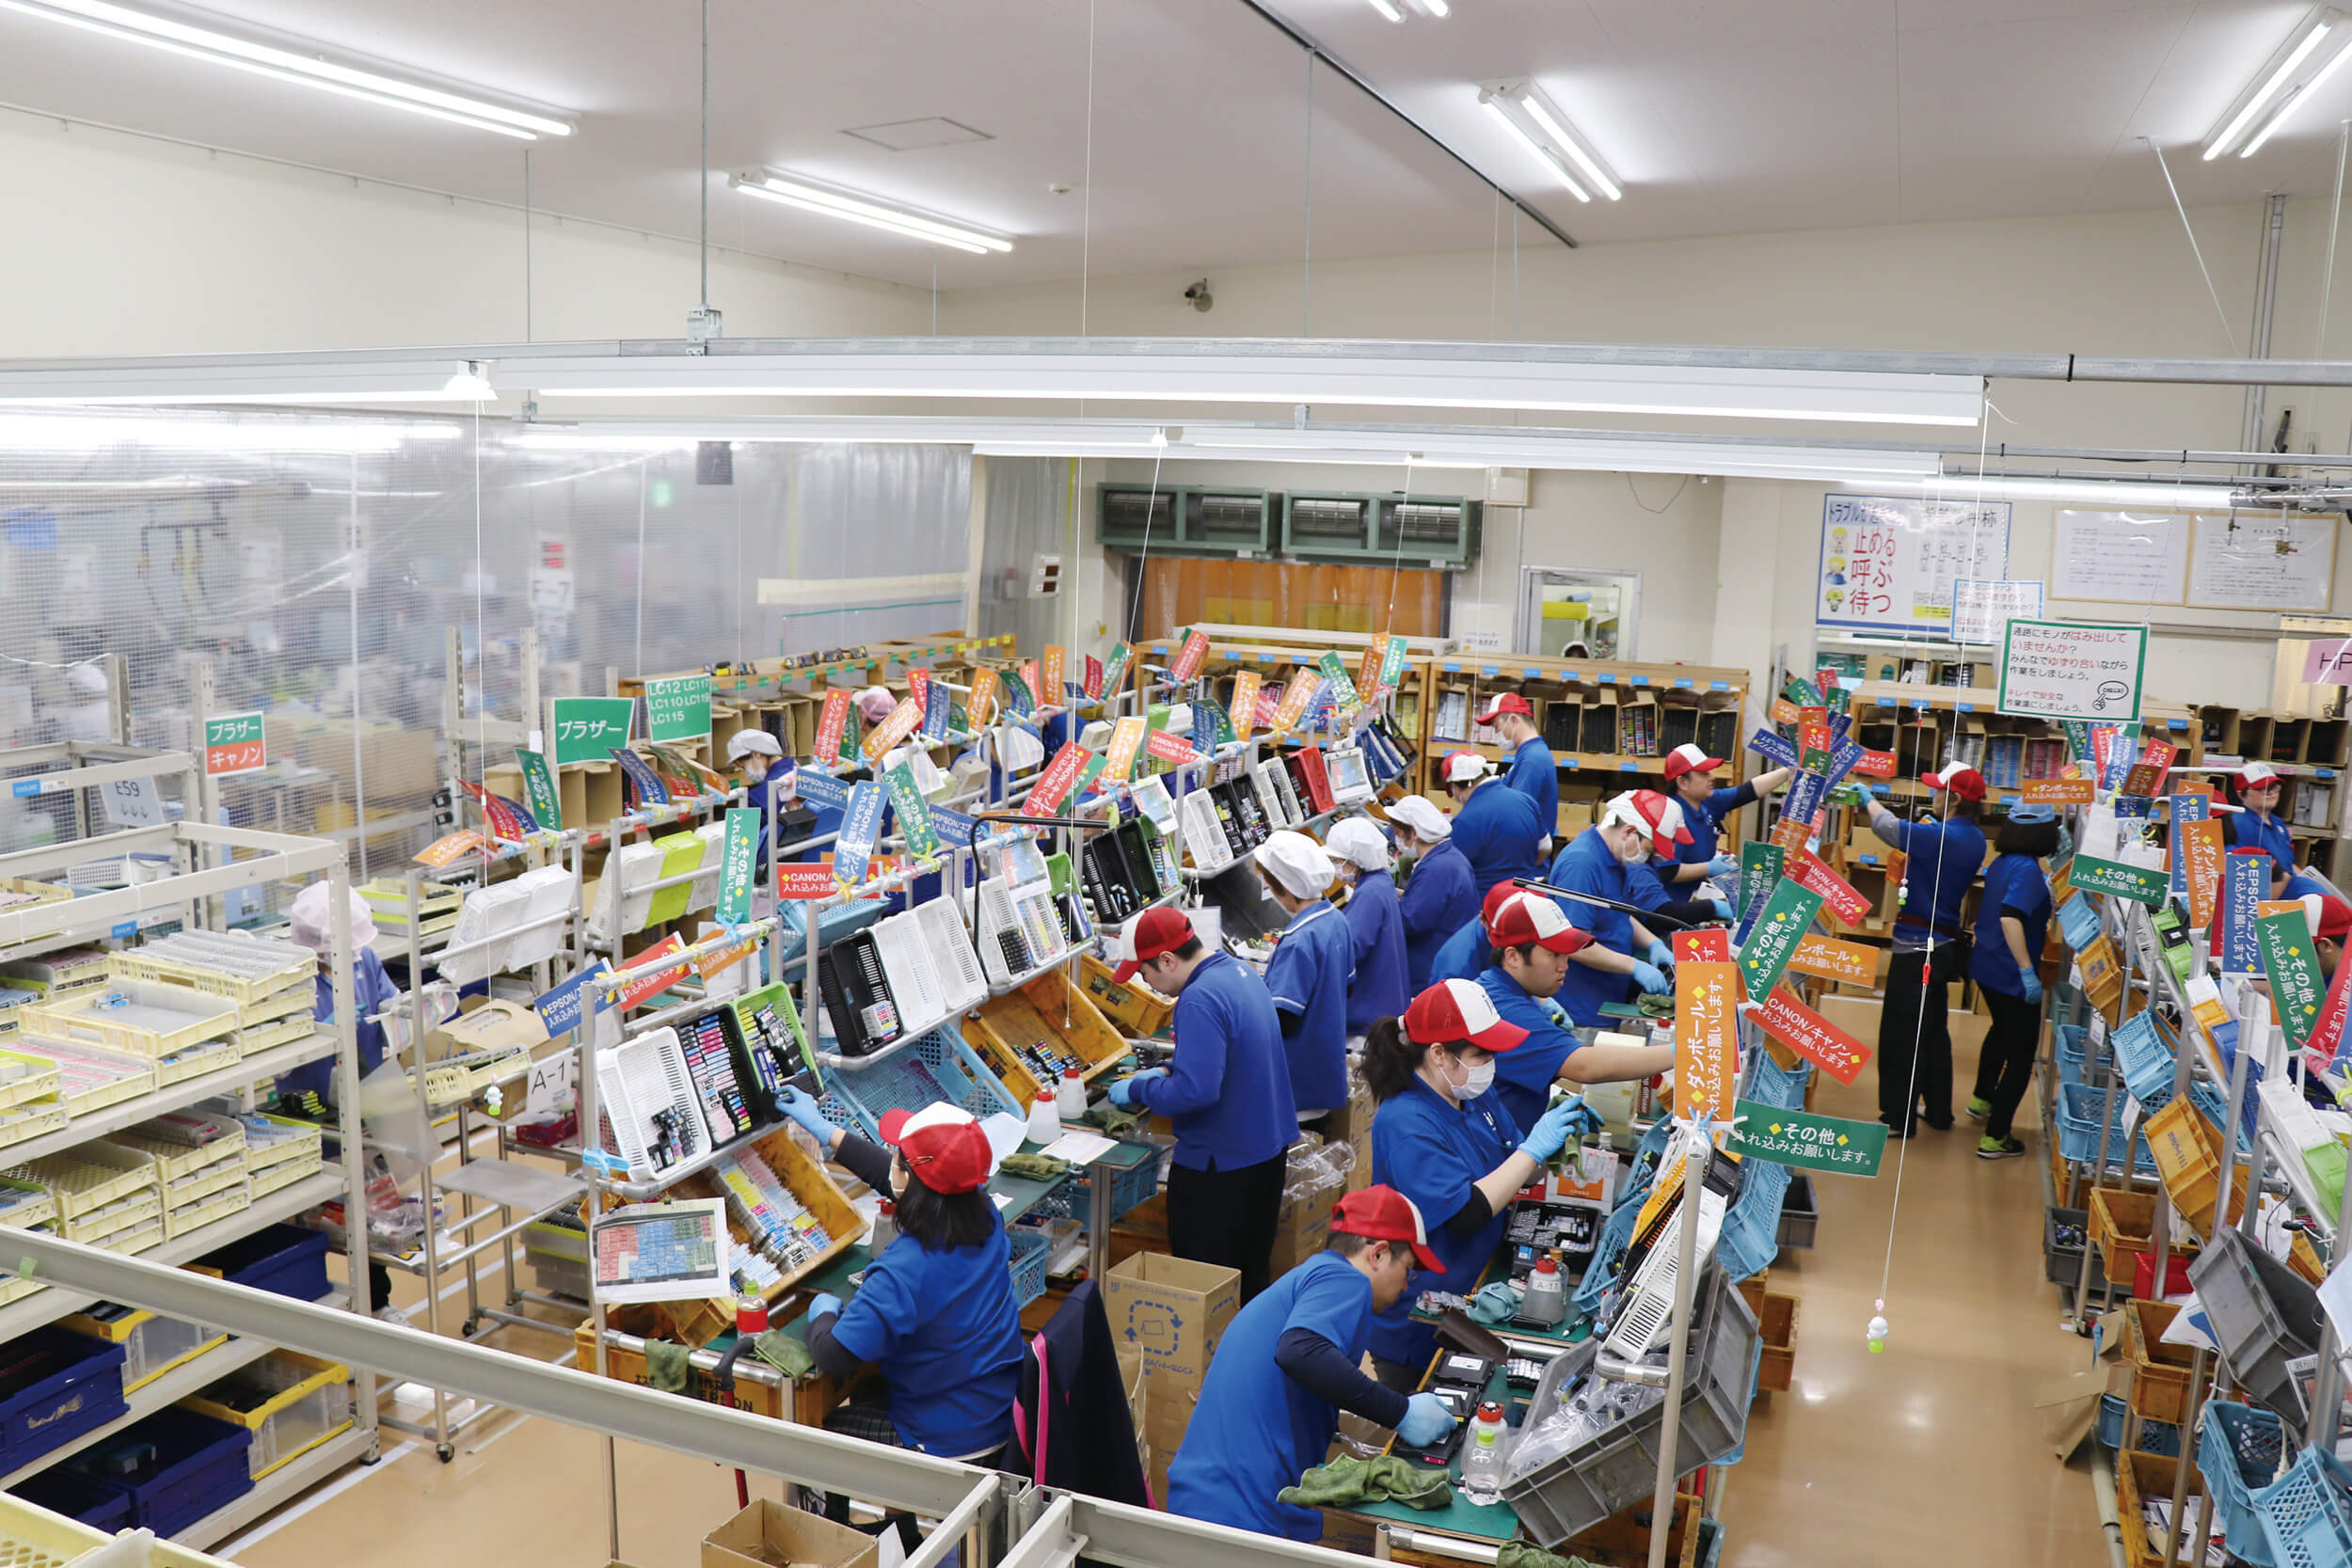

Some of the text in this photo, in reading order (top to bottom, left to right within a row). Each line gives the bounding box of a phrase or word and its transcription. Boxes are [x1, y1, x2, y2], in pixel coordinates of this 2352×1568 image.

[1852, 527, 1896, 556] 止める
[1851, 559, 1893, 587] 呼ぶ
[1850, 589, 1891, 615] 待つ
[2013, 627, 2128, 643] 通路にモノがはみ出して
[2010, 654, 2128, 670] みんなでゆずり合いながら
[2010, 666, 2090, 681] 作業をしましょう。
[649, 681, 681, 696] LC12
[2007, 689, 2063, 701] キレイで安全な
[650, 696, 683, 710] LC110
[651, 710, 685, 724] LC115
[210, 721, 260, 741] ブラザー
[558, 720, 623, 740] ブラザー
[211, 747, 262, 768] キャノン
[735, 847, 748, 887] その他
[790, 873, 833, 882] CANON/
[2104, 867, 2138, 882] その他
[1747, 899, 1813, 1001] 入れ込みお願いします。
[1752, 921, 1782, 959] その他
[1801, 942, 1849, 961] ンボール
[2292, 957, 2315, 1005] その他
[1769, 997, 1851, 1058] CANON/キャノン
[1687, 1002, 1707, 1092] ダンボール
[1708, 973, 1724, 1119] 入れ込みお願いします。
[1783, 1122, 1836, 1146] その他
[1732, 1132, 1871, 1166] 入れ込みお願いします。
